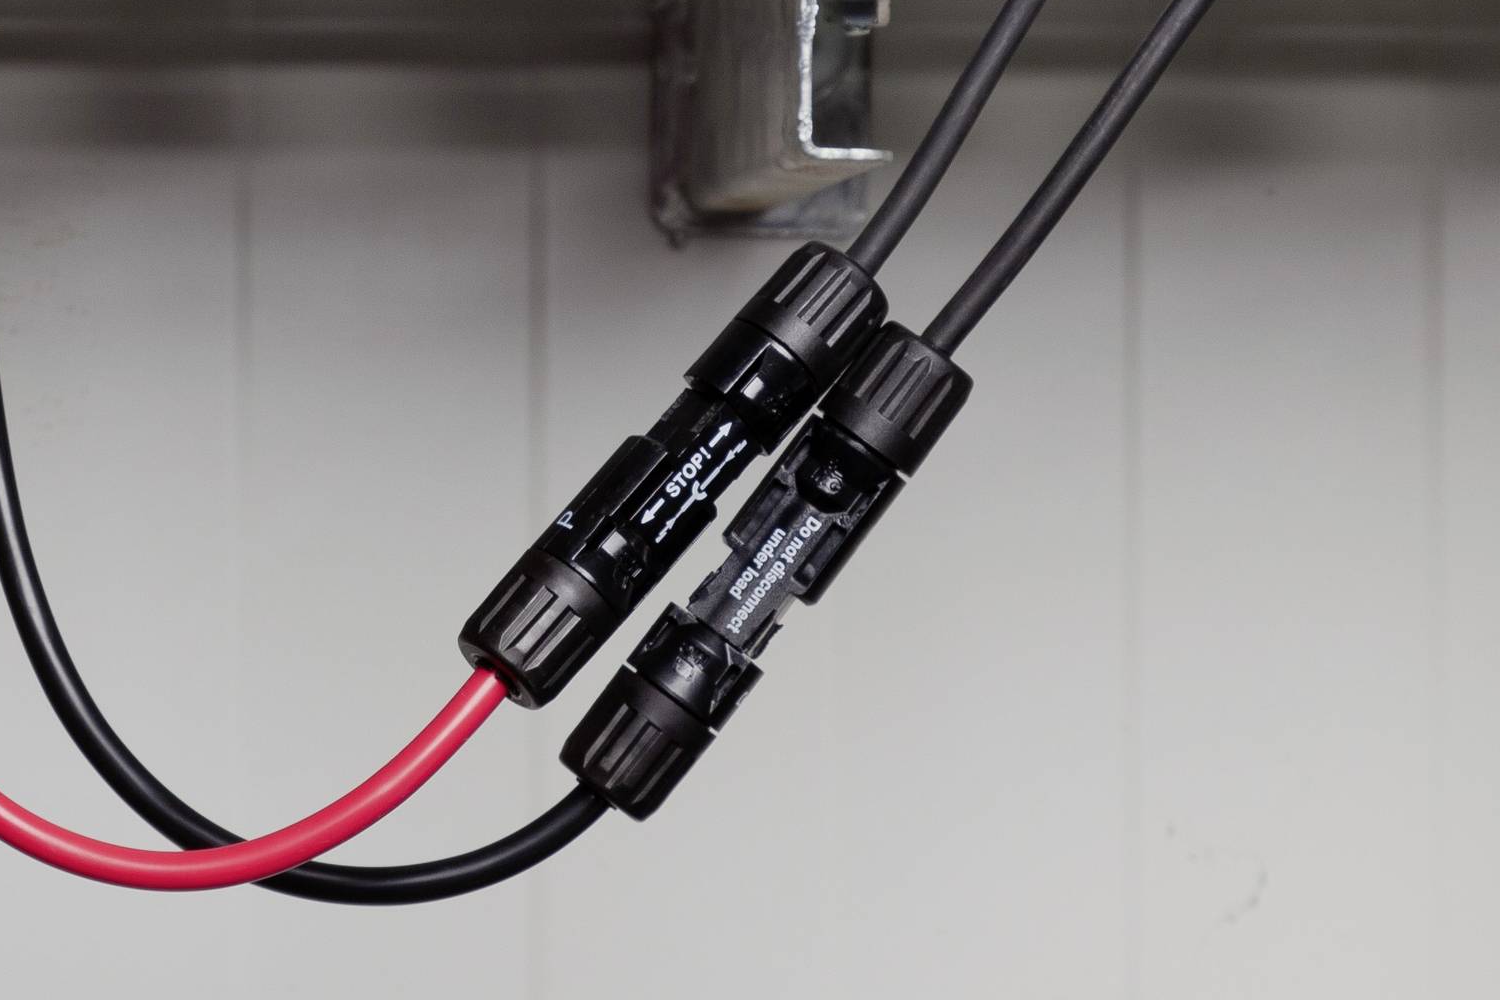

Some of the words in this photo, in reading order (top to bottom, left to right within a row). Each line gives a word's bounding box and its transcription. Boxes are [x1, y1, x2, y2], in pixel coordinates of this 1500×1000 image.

[665, 446, 712, 497] STOP!
[556, 510, 574, 530] P
[800, 515, 822, 541] Do
[752, 527, 787, 570] under
[781, 538, 804, 564] not
[726, 559, 786, 634] disconnect
[728, 565, 760, 600] load
